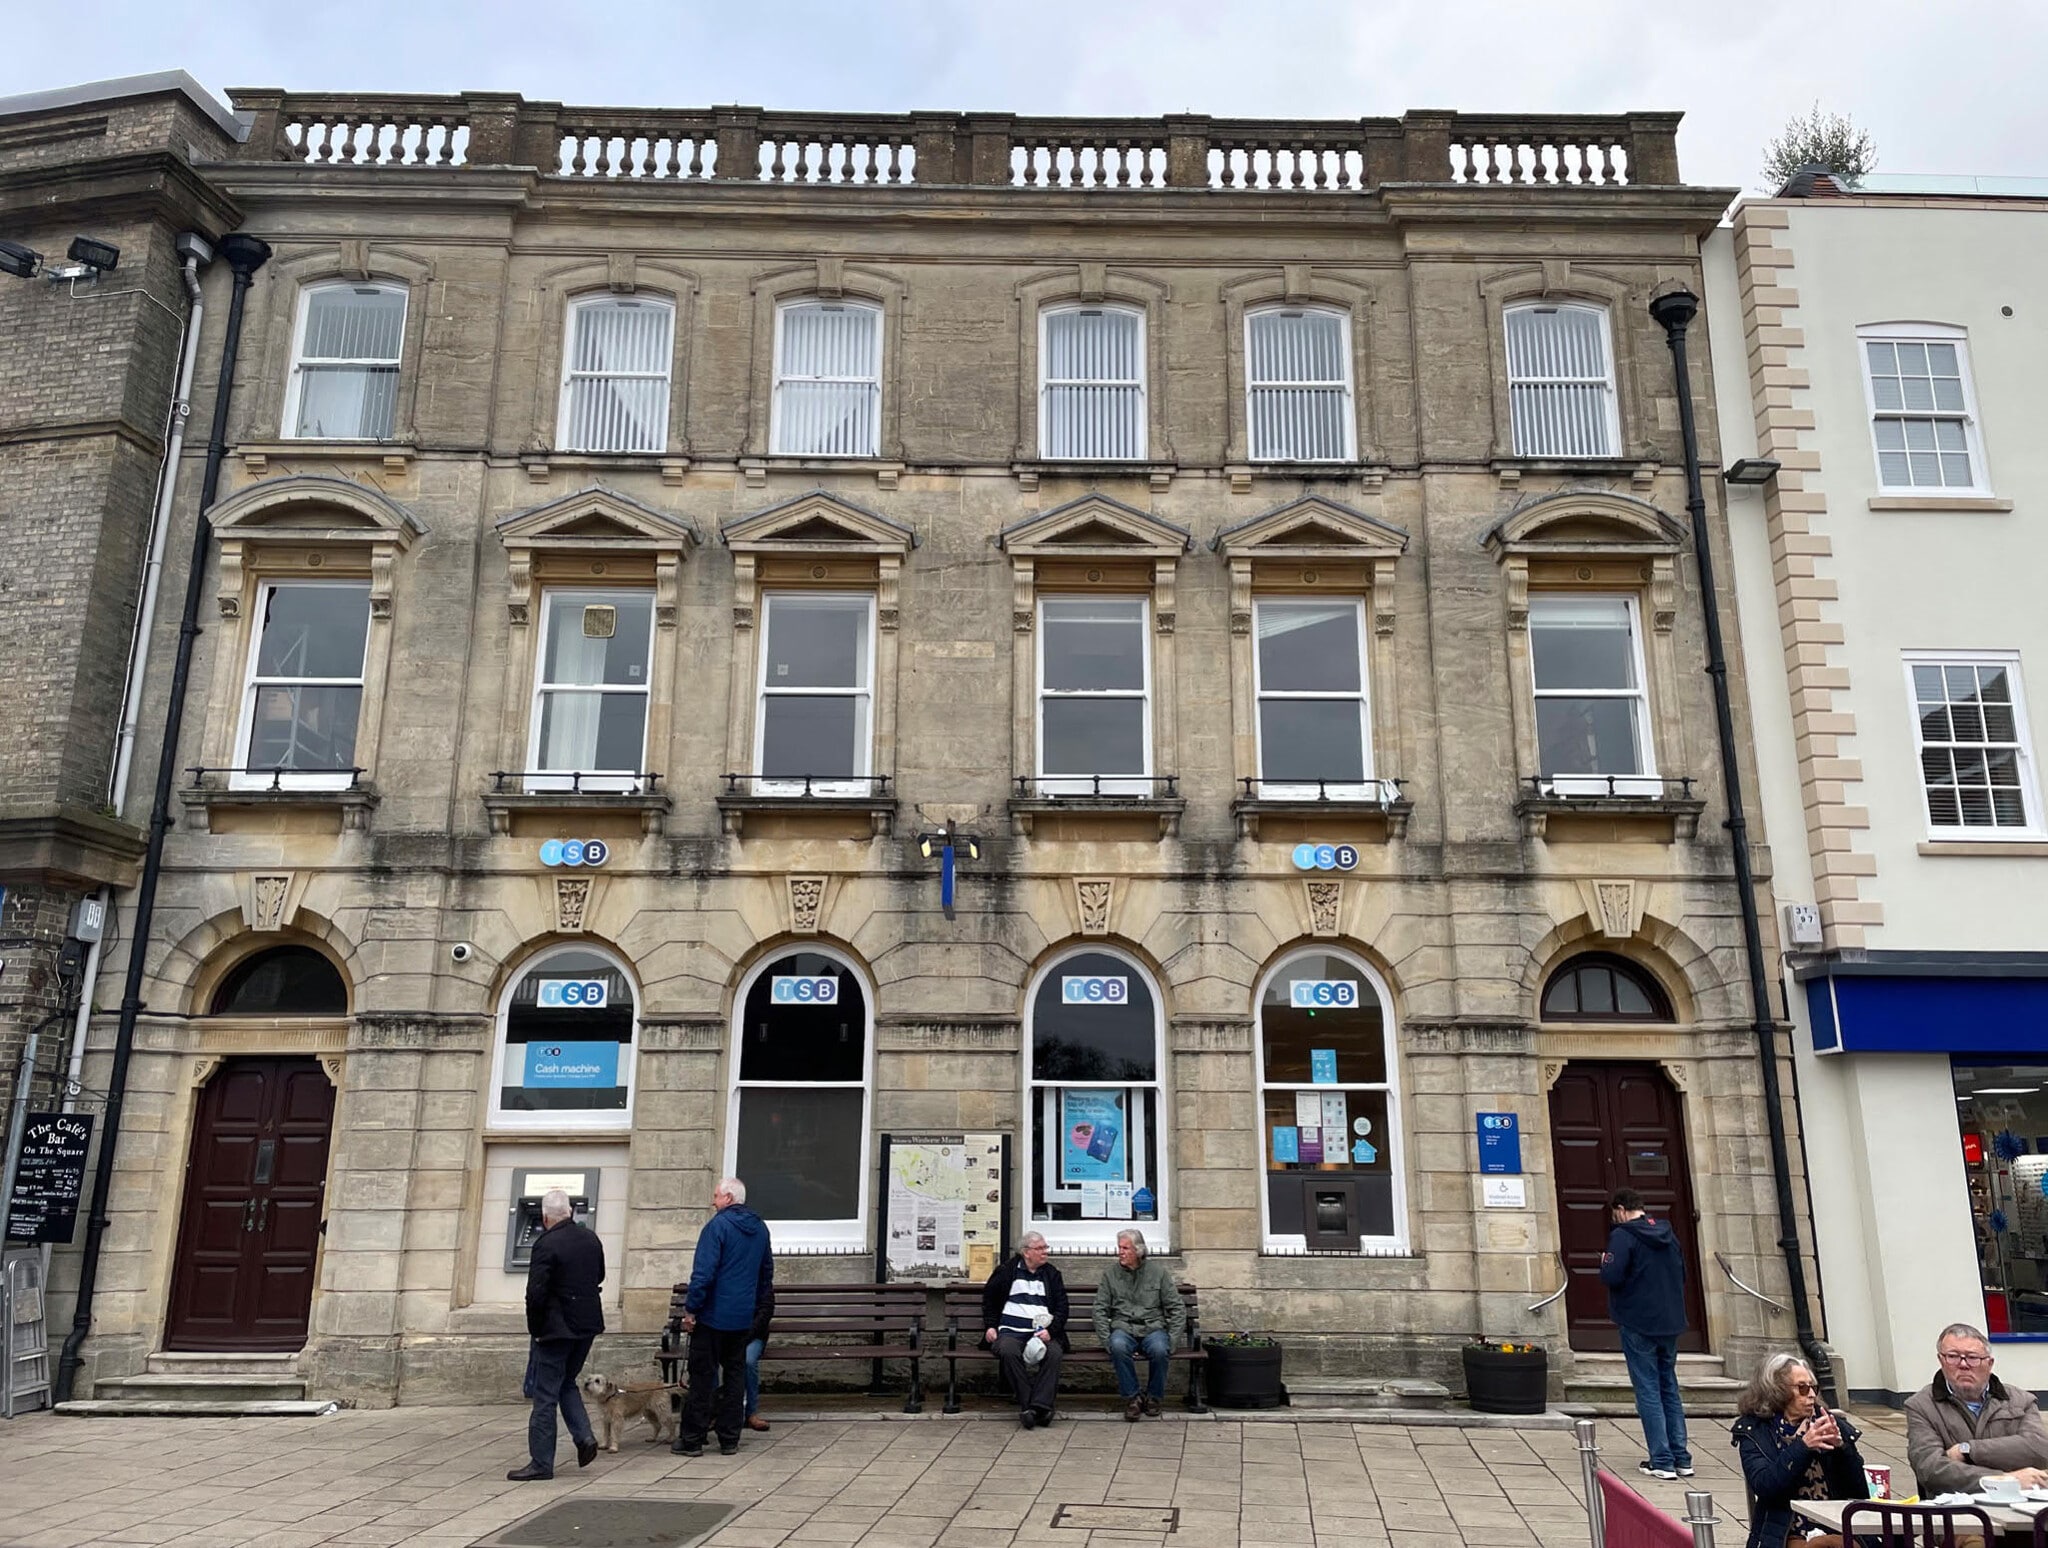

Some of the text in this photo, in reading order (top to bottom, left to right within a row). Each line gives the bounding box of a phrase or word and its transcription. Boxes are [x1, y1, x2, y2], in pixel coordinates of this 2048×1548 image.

[535, 1063, 600, 1073] Cash machine
[27, 1118, 87, 1141] The Café's
[47, 1132, 67, 1144] Bar
[23, 1146, 84, 1157] On The Square
